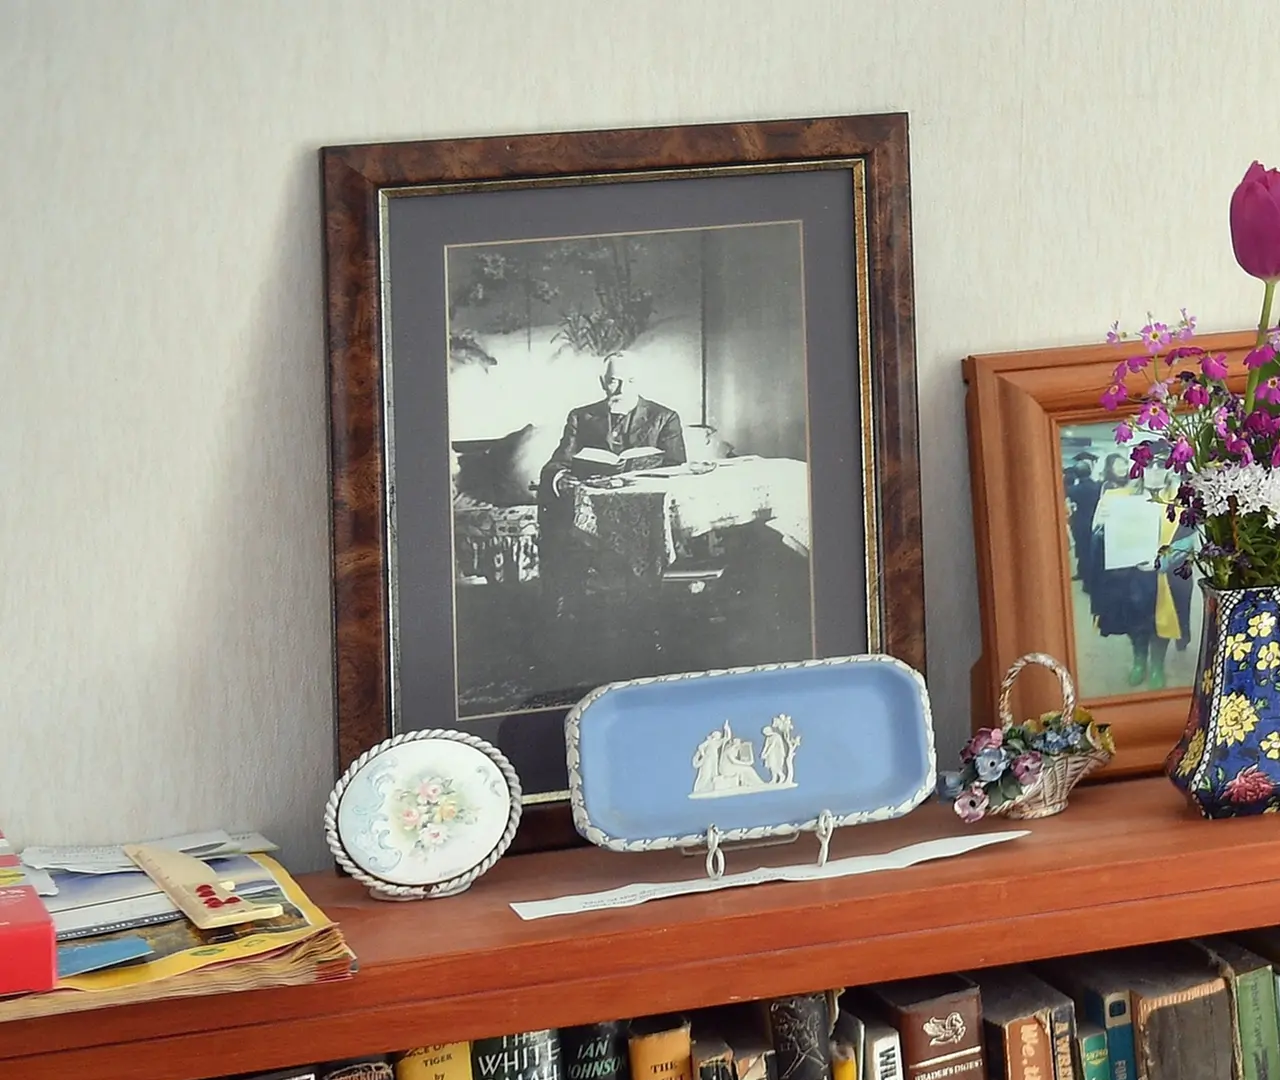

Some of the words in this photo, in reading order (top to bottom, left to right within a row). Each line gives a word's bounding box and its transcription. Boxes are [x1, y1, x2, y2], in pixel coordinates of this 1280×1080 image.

[479, 1038, 562, 1076] WHITE
[577, 1038, 608, 1060] IAN
[423, 1053, 453, 1067] TIGER
[650, 1062, 679, 1074] THE
[1114, 1059, 1128, 1080] FOR
